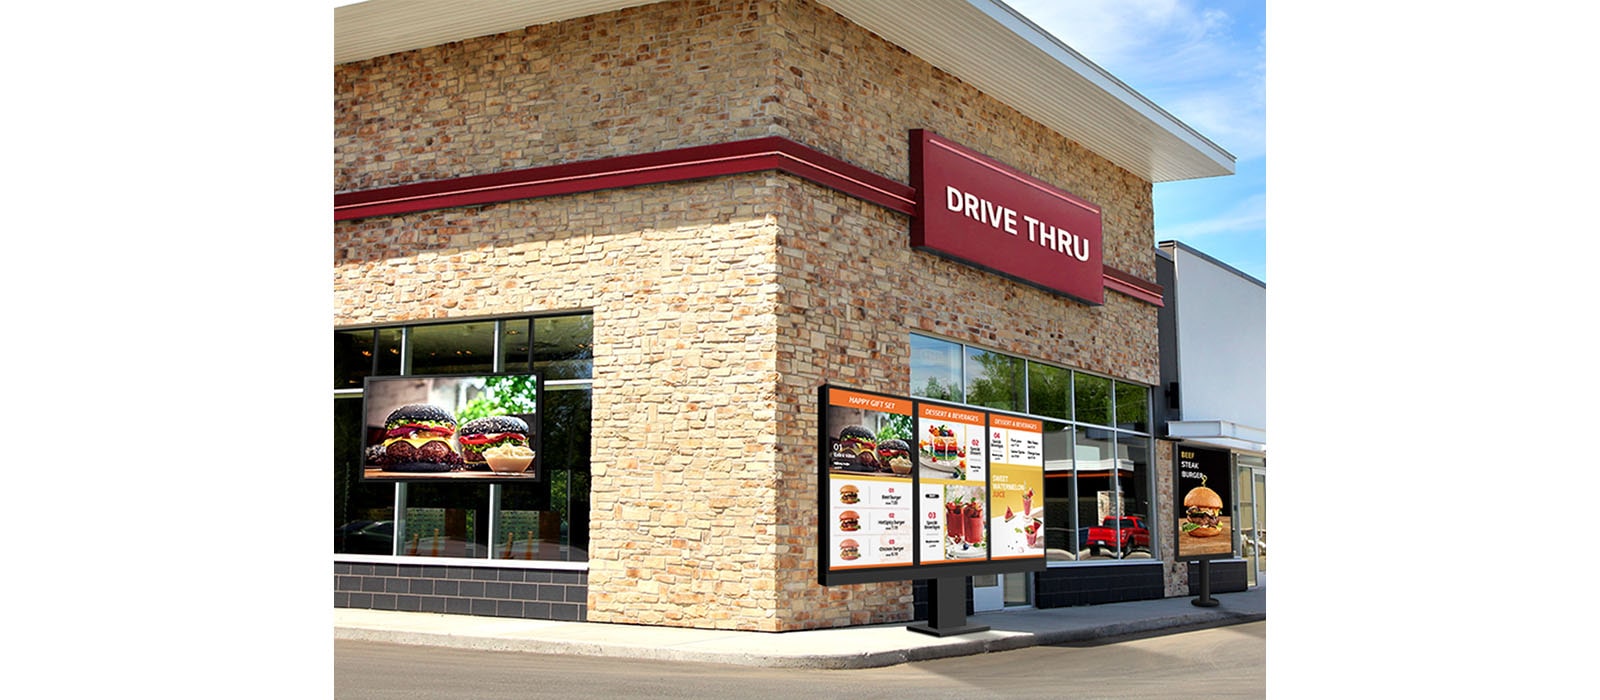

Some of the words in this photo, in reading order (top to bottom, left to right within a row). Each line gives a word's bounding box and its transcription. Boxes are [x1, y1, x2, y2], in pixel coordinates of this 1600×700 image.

[946, 185, 1018, 236] DRIVE
[1023, 214, 1090, 262] THRU
[848, 396, 870, 406] HAPPY
[870, 399, 884, 408] GIFT
[884, 402, 896, 410] SET
[925, 408, 947, 417] DESSERT
[952, 412, 979, 422] BEVERAGES
[833, 443, 842, 451] 01
[1181, 450, 1195, 459] BEEF
[1181, 460, 1200, 469] STEAK
[1181, 470, 1203, 479] BURGER
[928, 511, 936, 519] 03
